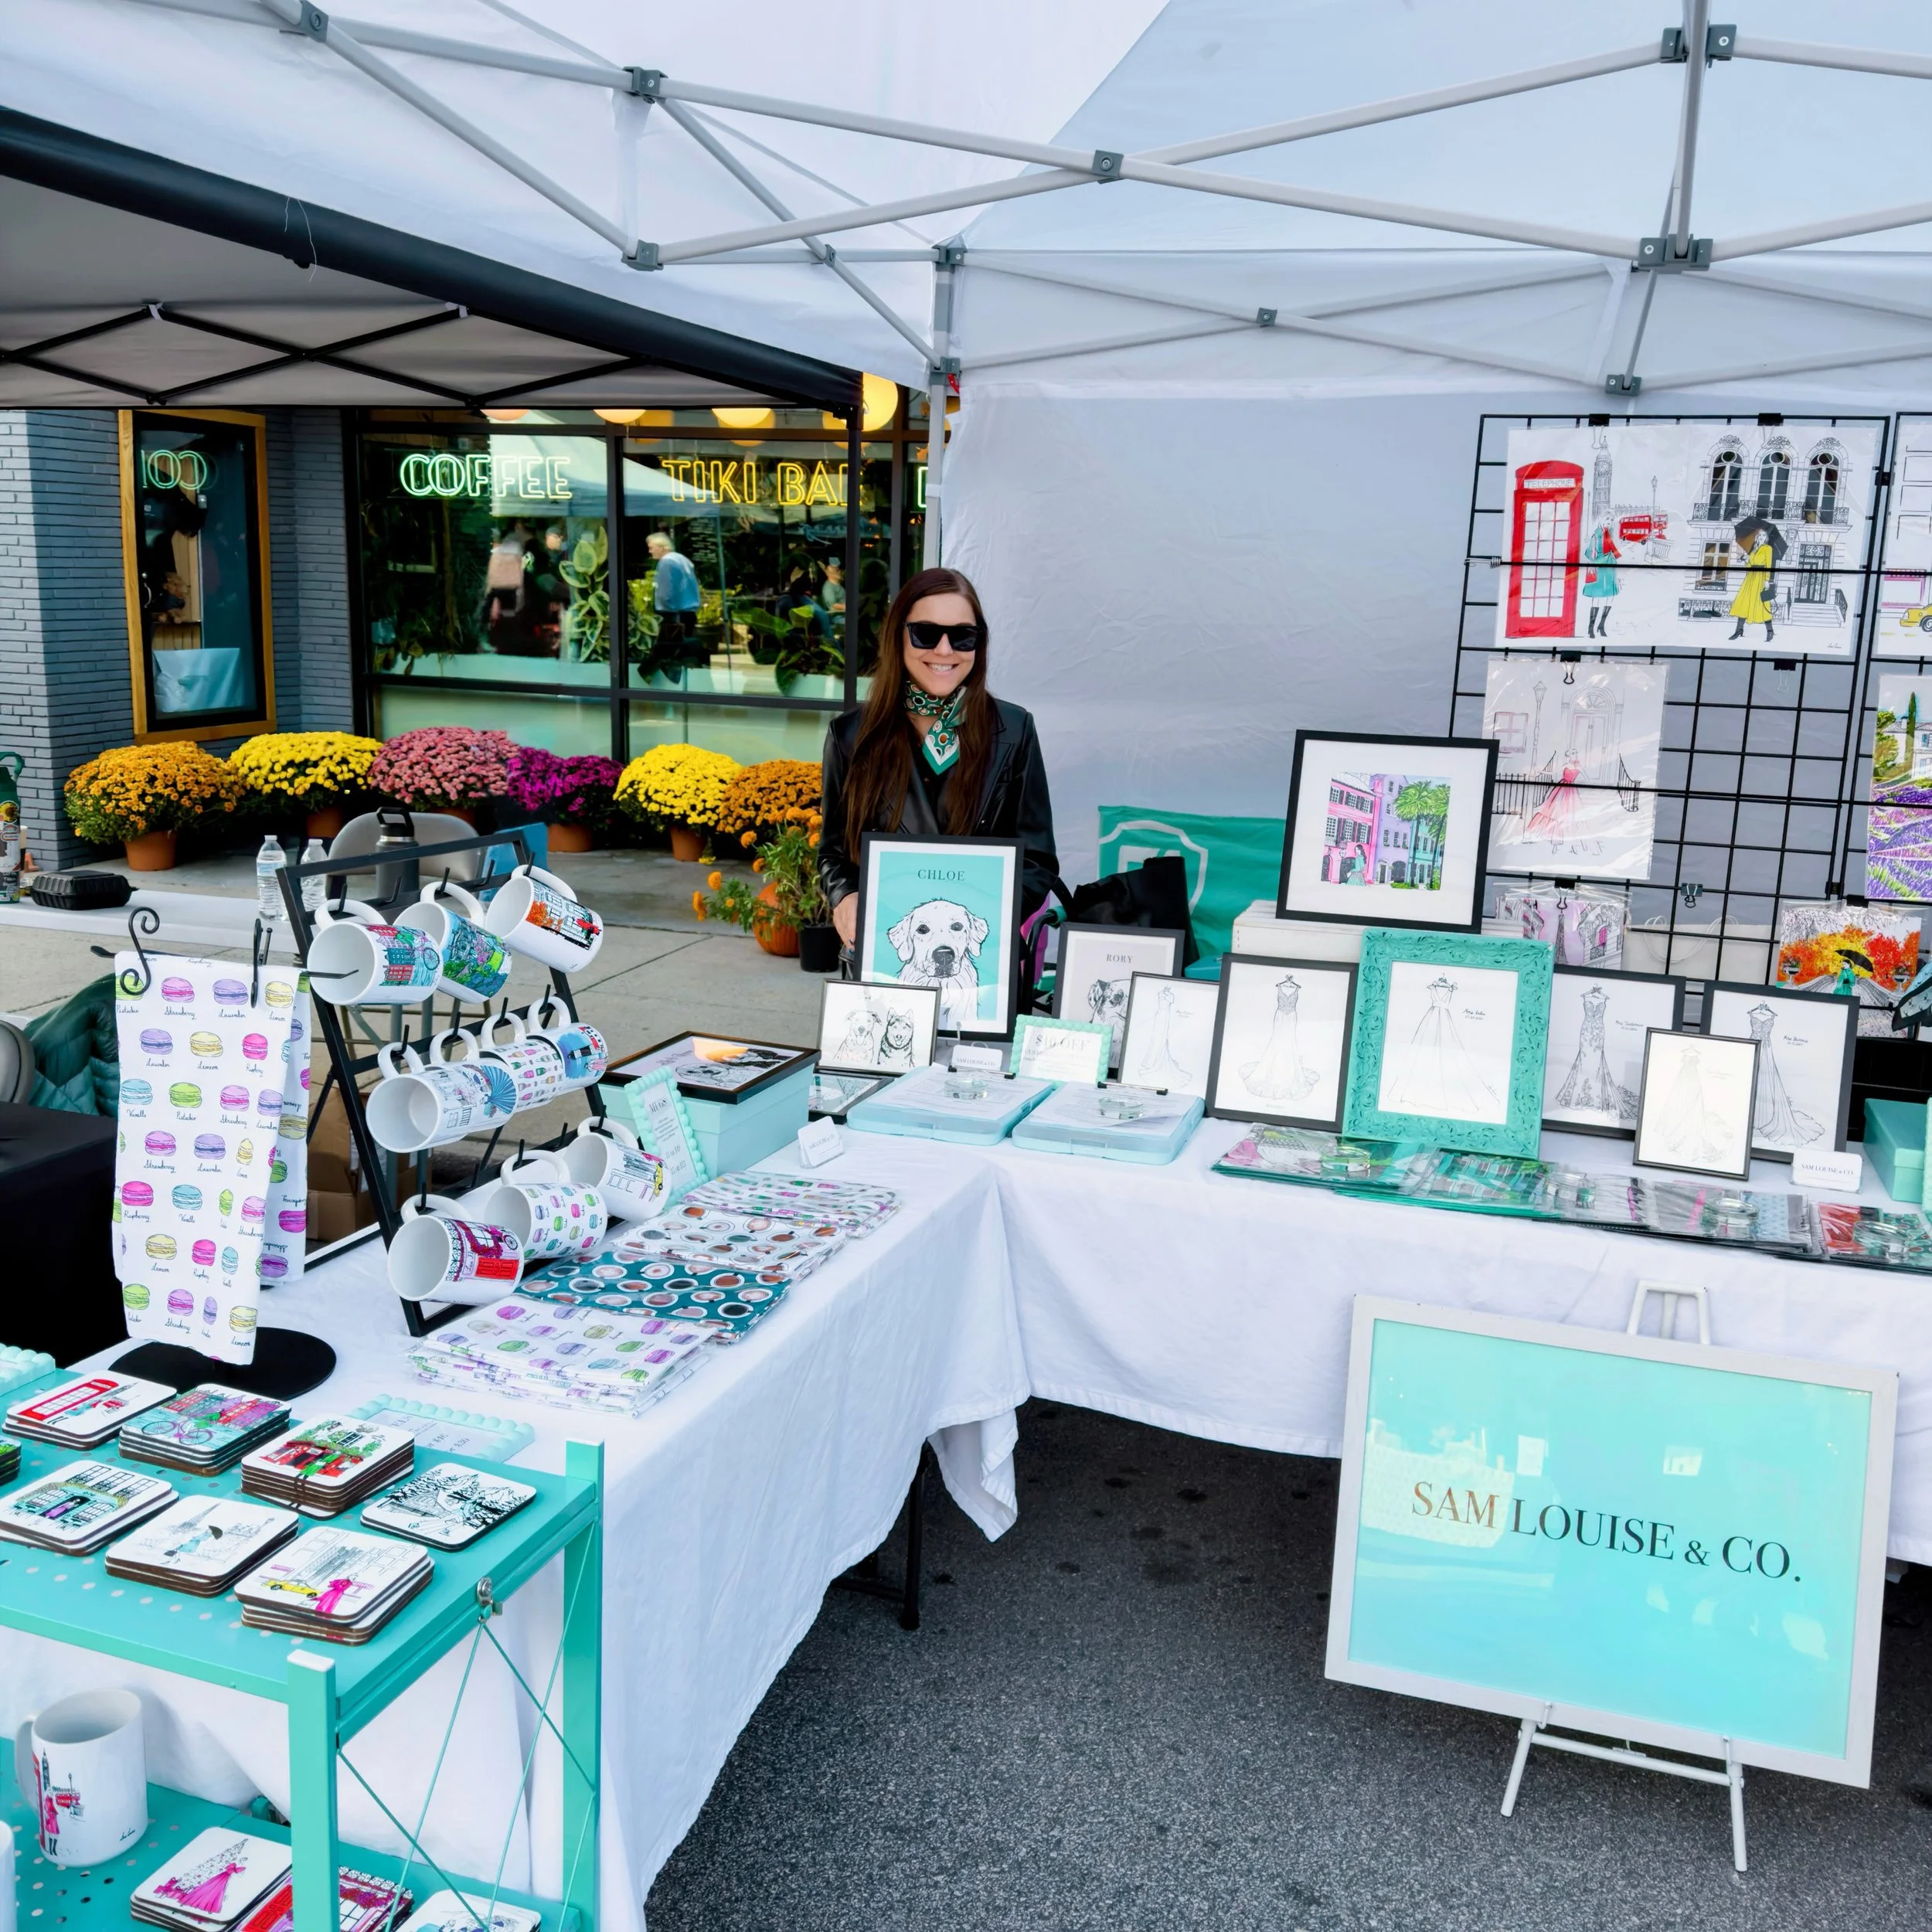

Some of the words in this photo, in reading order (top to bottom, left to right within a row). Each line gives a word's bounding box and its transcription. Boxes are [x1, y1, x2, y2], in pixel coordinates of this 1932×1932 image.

[400, 453, 573, 499] COFFEE
[662, 460, 757, 504] TIKI
[1525, 479, 1573, 488] TELEPHONE
[917, 869, 965, 881] CHLOE
[1106, 954, 1133, 964] RORY
[164, 1006, 196, 1020] Strawberry
[218, 1009, 246, 1018] Lavender
[197, 1060, 219, 1070] Lemon
[144, 1159, 176, 1174] Strawberry
[197, 1163, 223, 1172] Lavender
[1412, 1481, 1500, 1529] SAM
[1511, 1498, 1675, 1562] LOUISE
[1685, 1540, 1710, 1566] &
[1722, 1536, 1801, 1583] CO.
